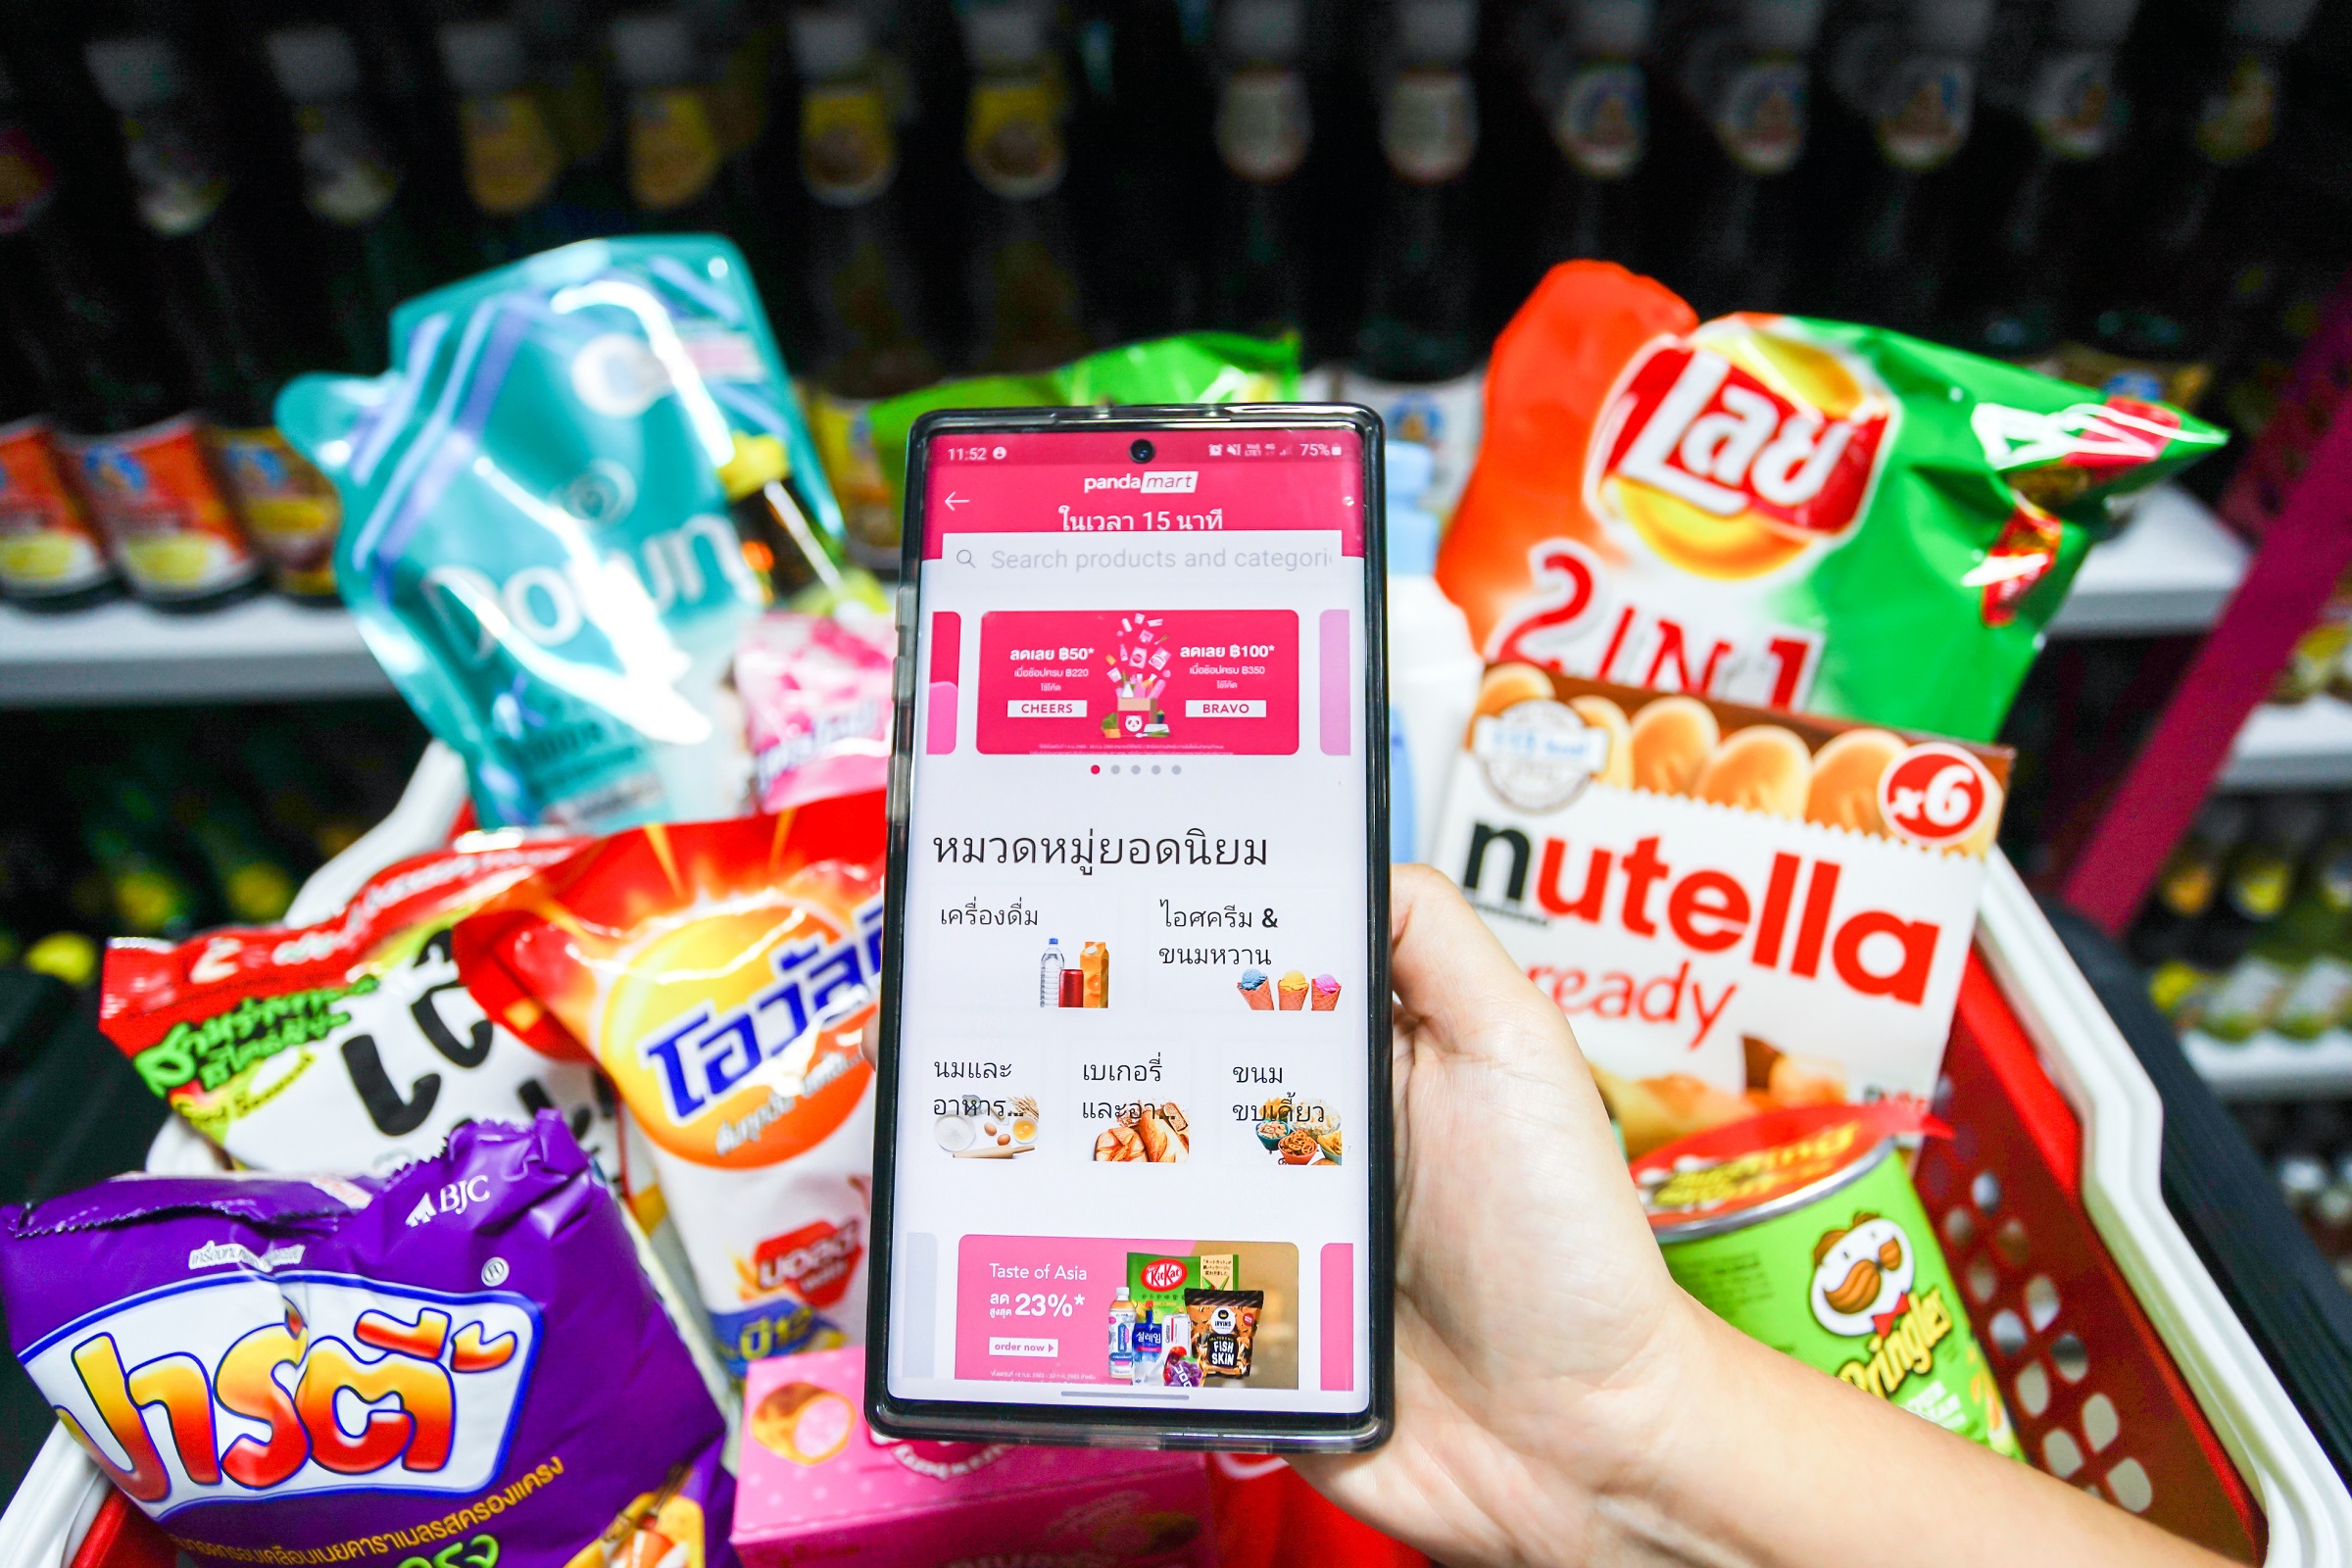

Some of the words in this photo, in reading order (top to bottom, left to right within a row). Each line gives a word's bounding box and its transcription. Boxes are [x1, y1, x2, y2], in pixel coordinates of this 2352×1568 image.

[948, 448, 987, 461] 11:52
[1300, 444, 1330, 457] 75%
[1058, 505, 1134, 531] ในเวลา
[1143, 511, 1170, 530] 15
[1177, 508, 1223, 530] นาที
[991, 550, 1067, 568] Search
[1076, 549, 1176, 571] products
[1185, 549, 1226, 567] and
[1235, 549, 1333, 571] categori
[1498, 552, 1593, 668] 2
[1599, 607, 1733, 695] IN
[1770, 637, 1809, 711] 1
[1009, 649, 1054, 661] ลดเลย
[1180, 647, 1225, 658] ลดเลย
[1021, 704, 1073, 713] CHEERS
[1202, 704, 1250, 713] BRAVO
[1889, 765, 1975, 820] x6
[933, 828, 1268, 875] หมวดหมู่ยอดนิยม
[941, 897, 1039, 926] เครื่องดื่ม
[1160, 899, 1253, 928] ไอศครีม
[1261, 907, 1279, 928] &
[1462, 820, 1941, 1007] nutella
[1158, 945, 1272, 965] ขนมหวาน
[934, 1058, 1012, 1078] นมและ
[1083, 1053, 1163, 1082] เบเกอรี่
[1232, 1065, 1284, 1085] ขนม
[1232, 1092, 1325, 1124] ขบเคี้ยว
[440, 1175, 490, 1215] BJC
[989, 1263, 1029, 1279] Taste
[1034, 1264, 1051, 1280] of
[1054, 1265, 1088, 1280] Asia
[989, 1293, 1009, 1305] ลด
[995, 1342, 1021, 1351] order
[1214, 1341, 1234, 1353] FISH
[1211, 1352, 1235, 1365] SKIN
